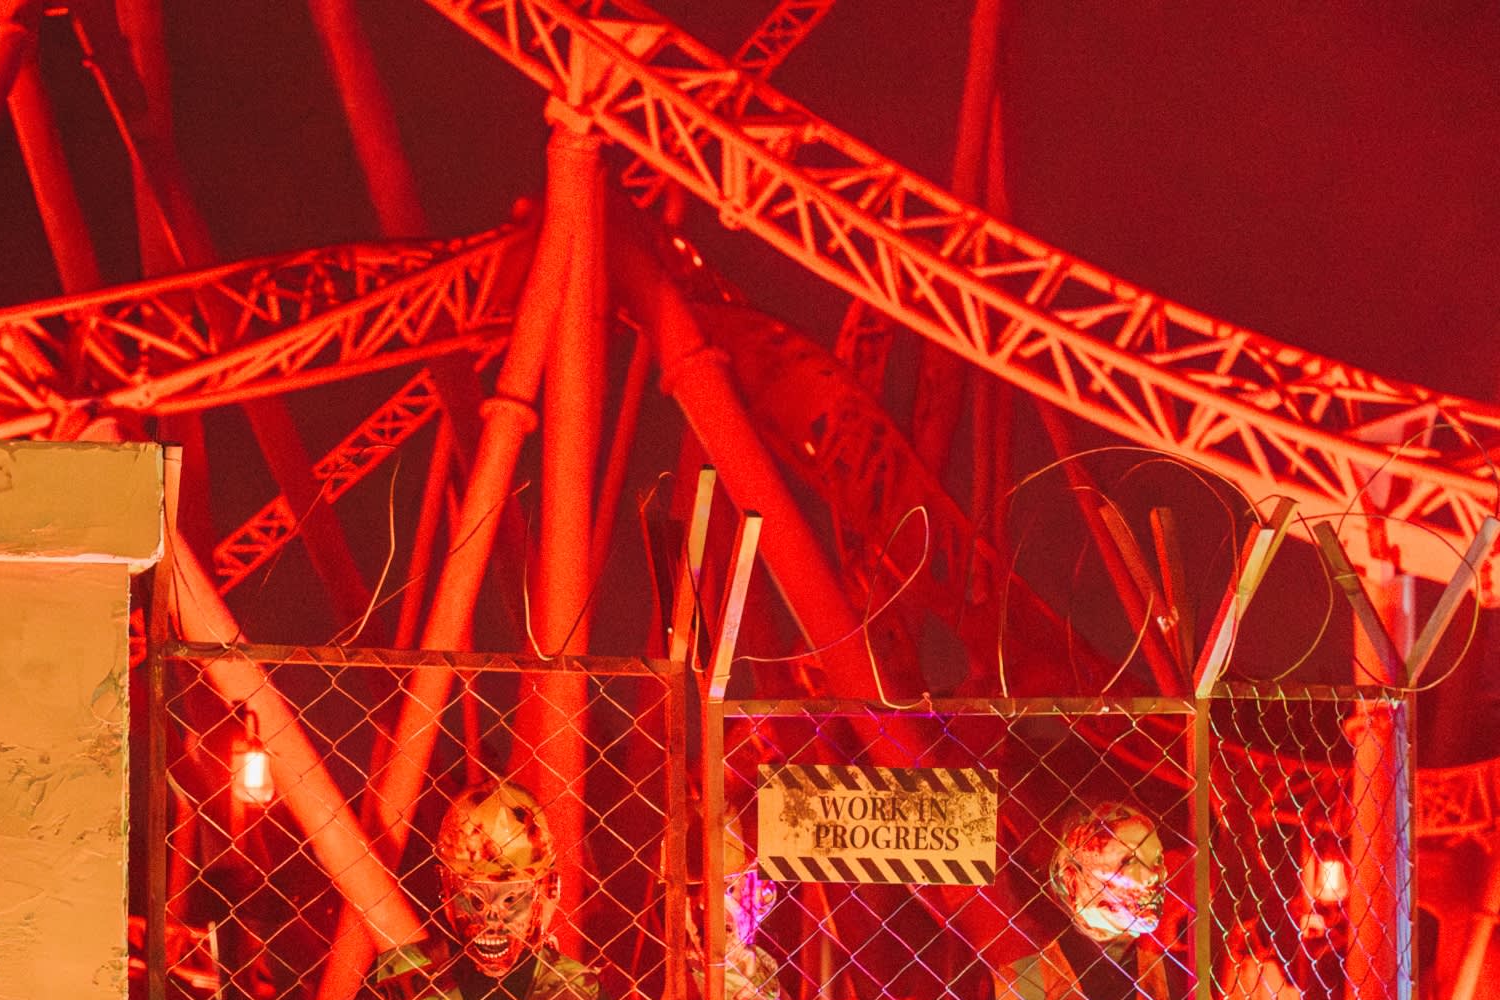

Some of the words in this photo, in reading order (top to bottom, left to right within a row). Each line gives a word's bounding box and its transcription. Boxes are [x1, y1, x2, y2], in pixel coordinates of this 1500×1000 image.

[819, 796, 911, 822] WORK
[918, 798, 950, 822] IN
[814, 824, 960, 850] PROGRESS
